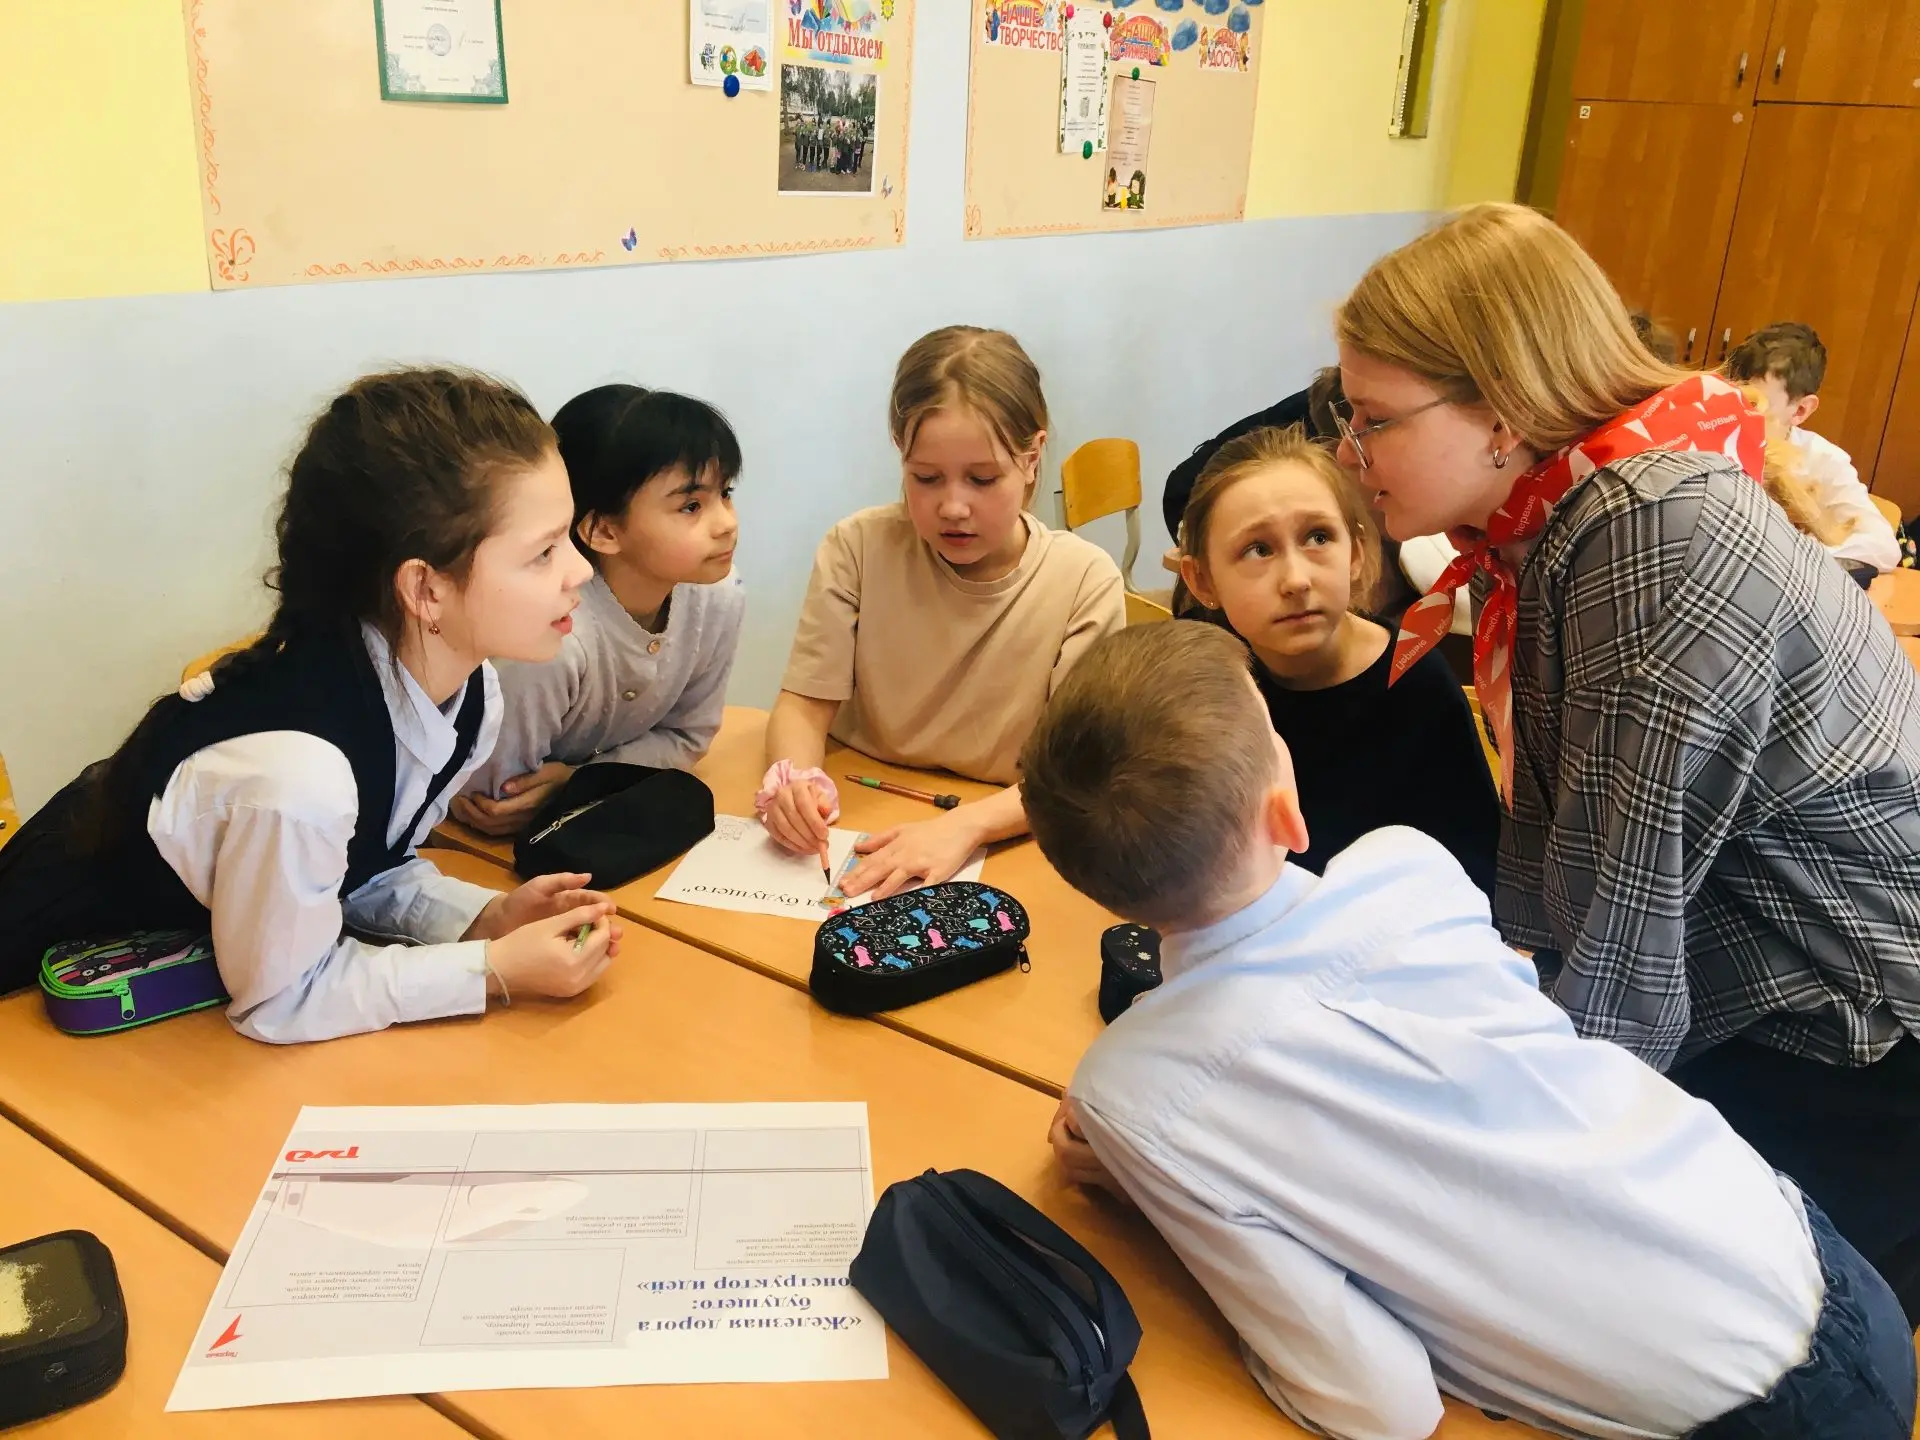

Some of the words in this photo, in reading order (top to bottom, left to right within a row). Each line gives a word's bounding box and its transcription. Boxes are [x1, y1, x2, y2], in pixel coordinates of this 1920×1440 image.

[1000, 3, 1041, 27] НАШЕ
[787, 18, 813, 49] Мы
[817, 29, 884, 60] отдыхаем
[1000, 25, 1064, 51] ТВОРЧЕСТВО
[1696, 413, 1738, 432] Первые
[1513, 494, 1536, 536] Первые
[637, 1280, 705, 1294] идей»
[713, 1275, 850, 1290] онструктор
[692, 1294, 811, 1310] будущего:
[638, 1317, 721, 1331] дорога
[729, 1316, 862, 1330] «Железная
